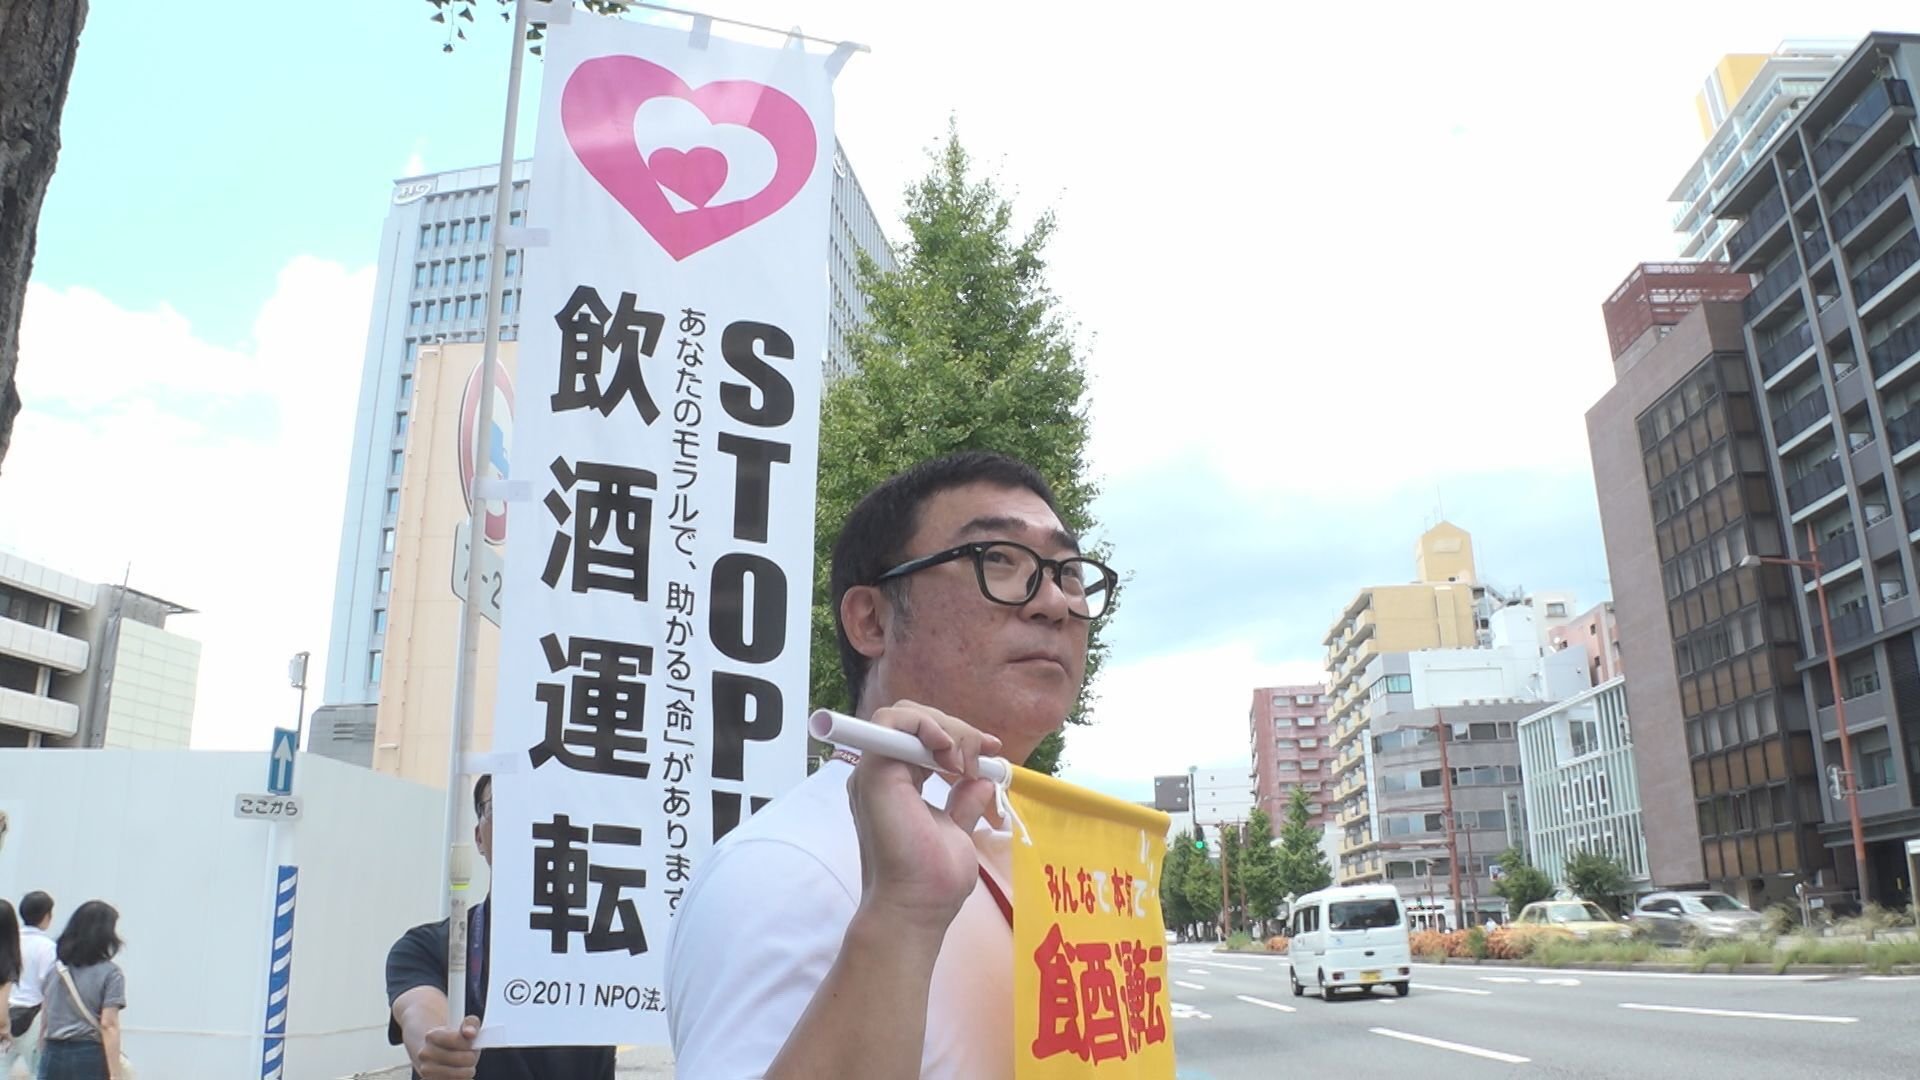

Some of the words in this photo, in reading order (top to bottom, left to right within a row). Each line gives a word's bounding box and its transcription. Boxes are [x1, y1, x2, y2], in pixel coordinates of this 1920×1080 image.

[528, 285, 666, 957] 飲酒運転
[240, 799, 298, 816] ここから
[594, 983, 667, 1012] NPO法
